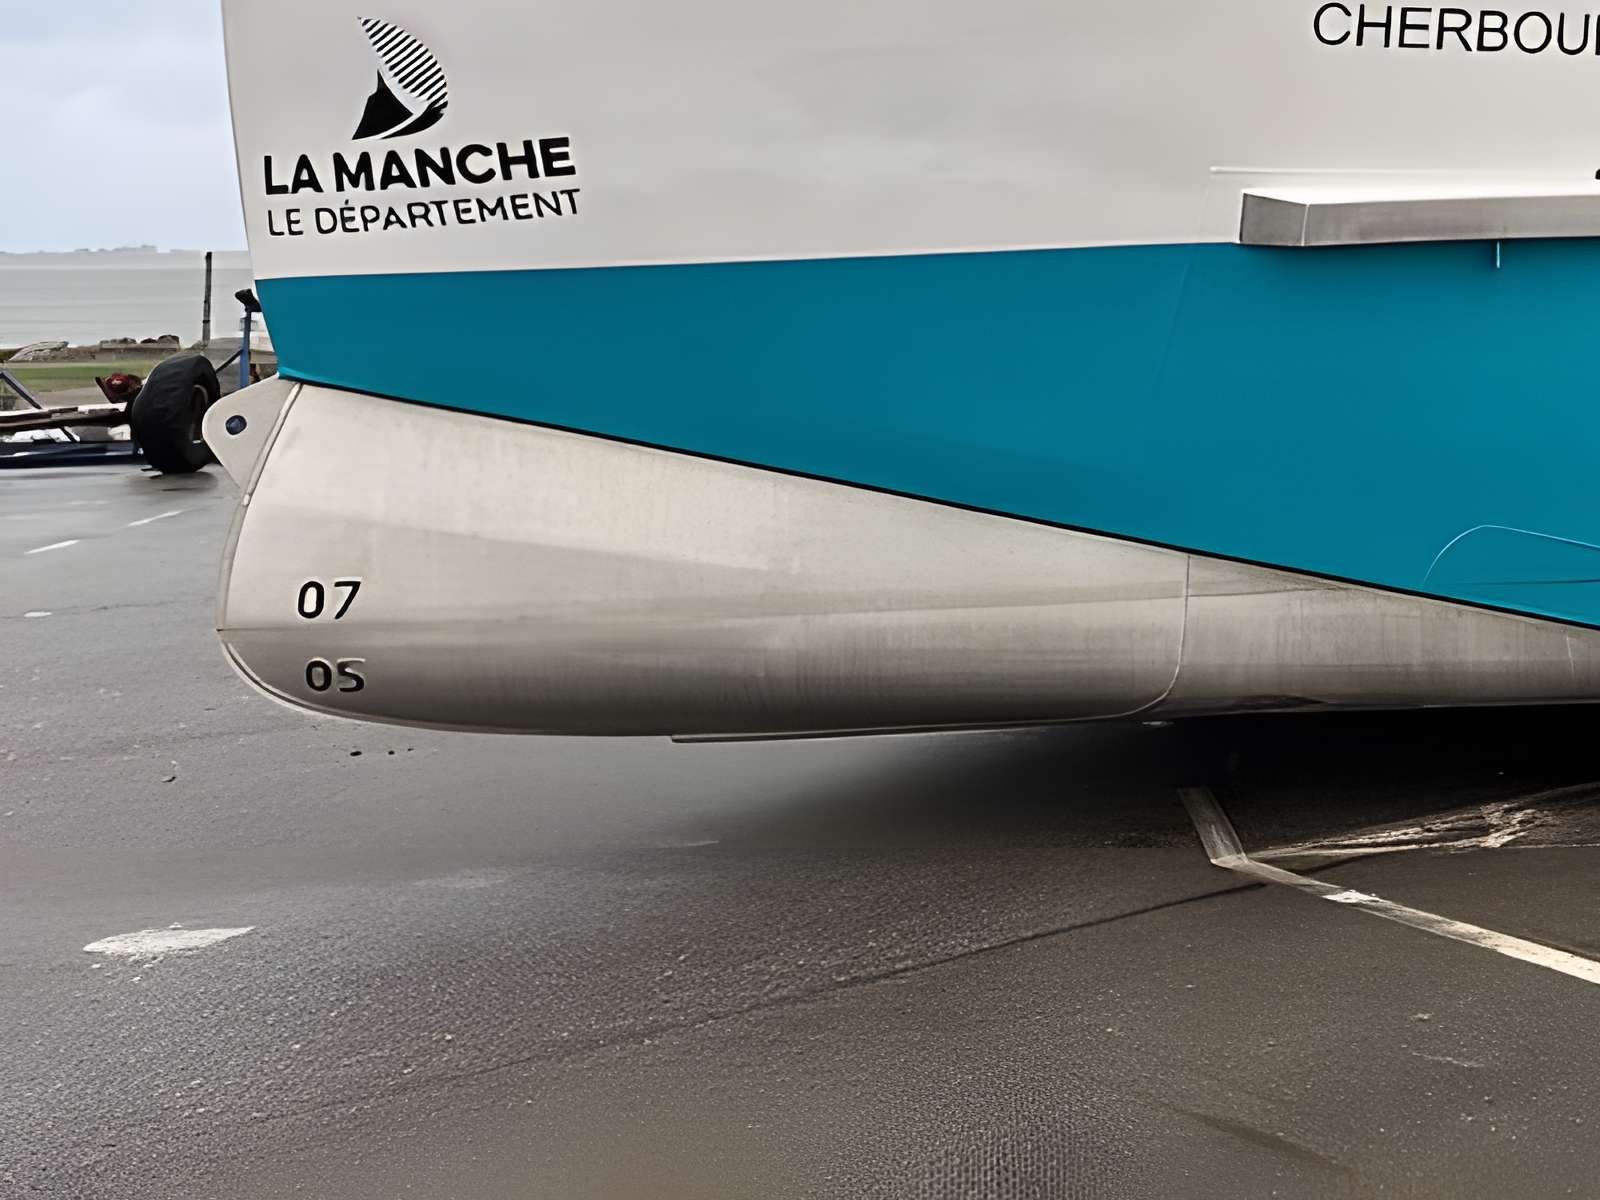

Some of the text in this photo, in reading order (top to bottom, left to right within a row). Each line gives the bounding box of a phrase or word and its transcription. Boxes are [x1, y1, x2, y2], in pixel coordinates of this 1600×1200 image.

[263, 136, 577, 196] LA MANCHE
[267, 188, 581, 237] LE DÉPARTEMENT
[297, 580, 362, 620] 07
[305, 658, 366, 693] 05
